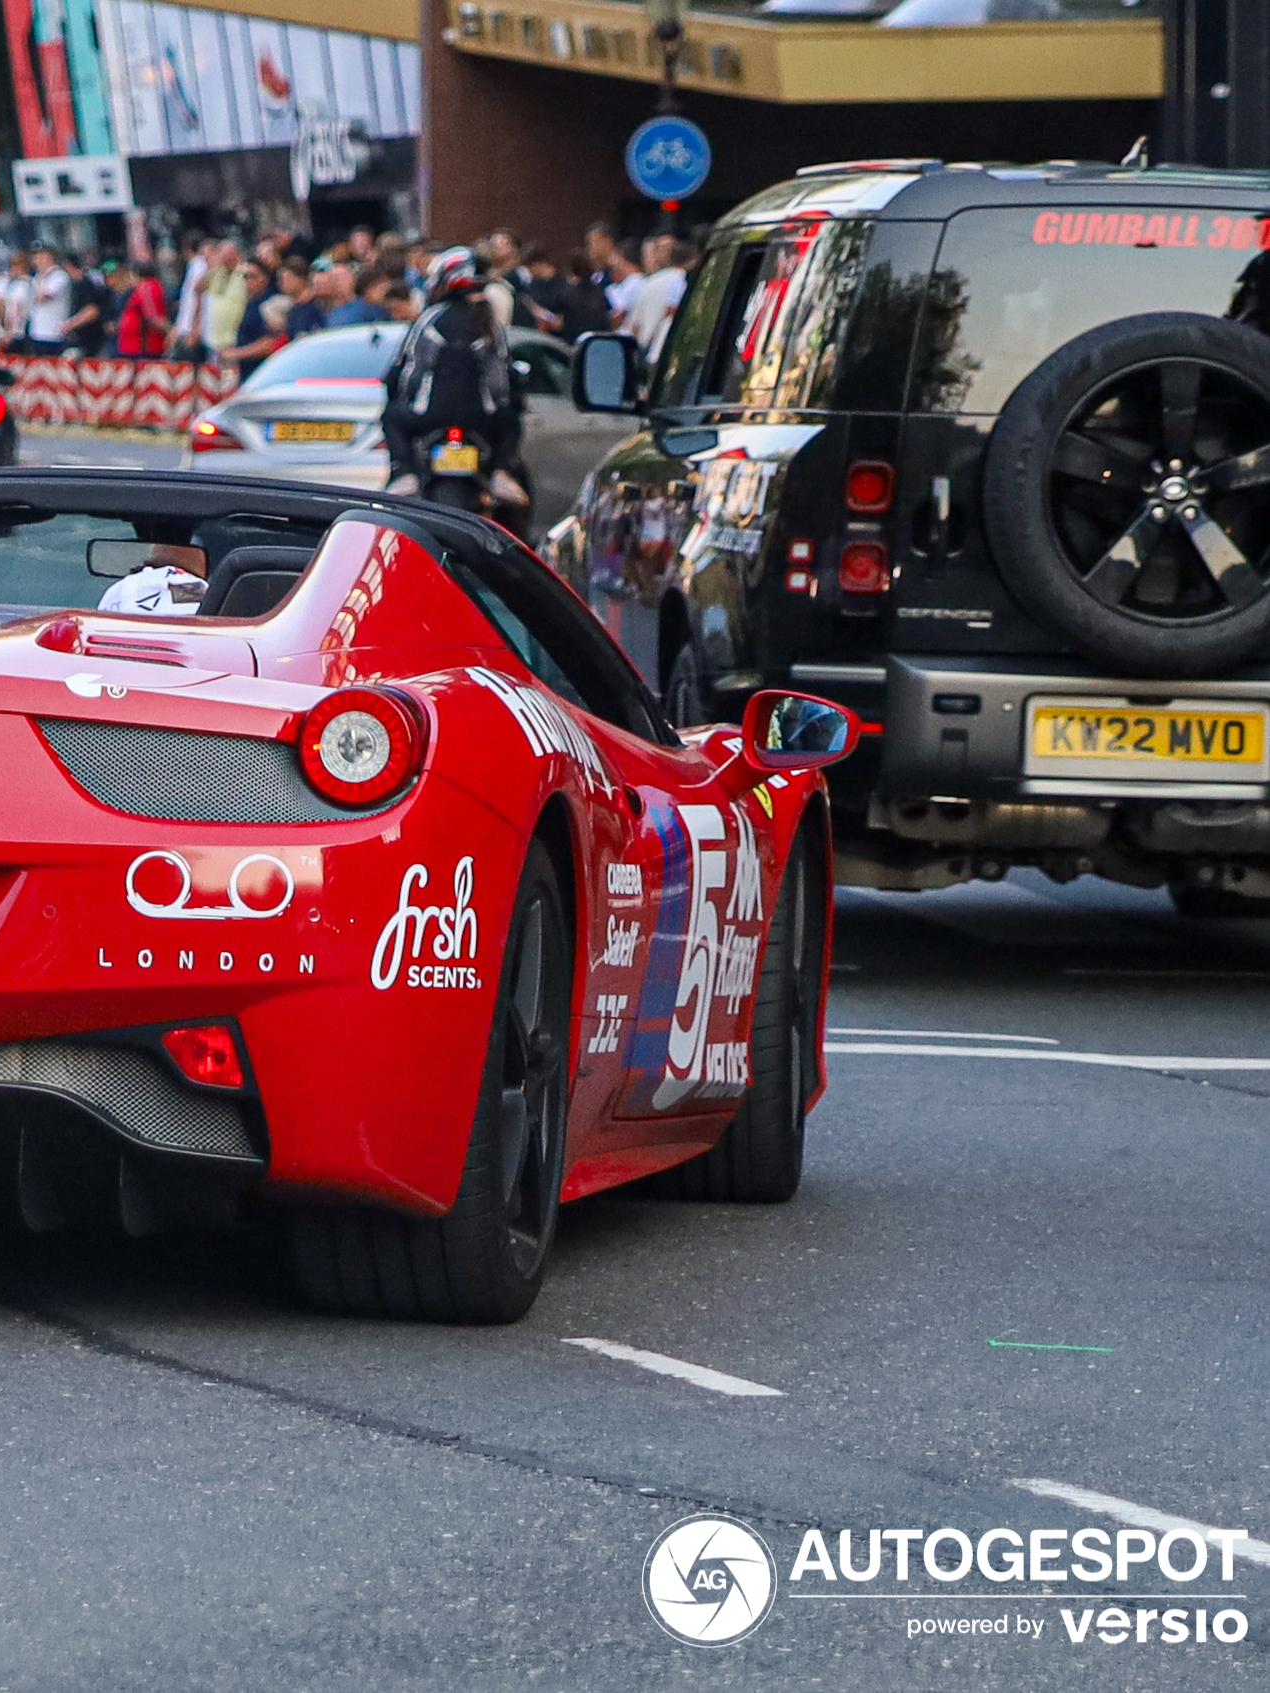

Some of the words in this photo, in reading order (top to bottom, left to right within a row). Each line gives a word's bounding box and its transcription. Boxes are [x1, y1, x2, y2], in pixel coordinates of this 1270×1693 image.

[1032, 212, 1200, 247] GUMBALL
[1052, 716, 1156, 753] KW22
[1168, 719, 1245, 756] MVO
[371, 855, 478, 990] frsh
[98, 948, 315, 974] LONDON
